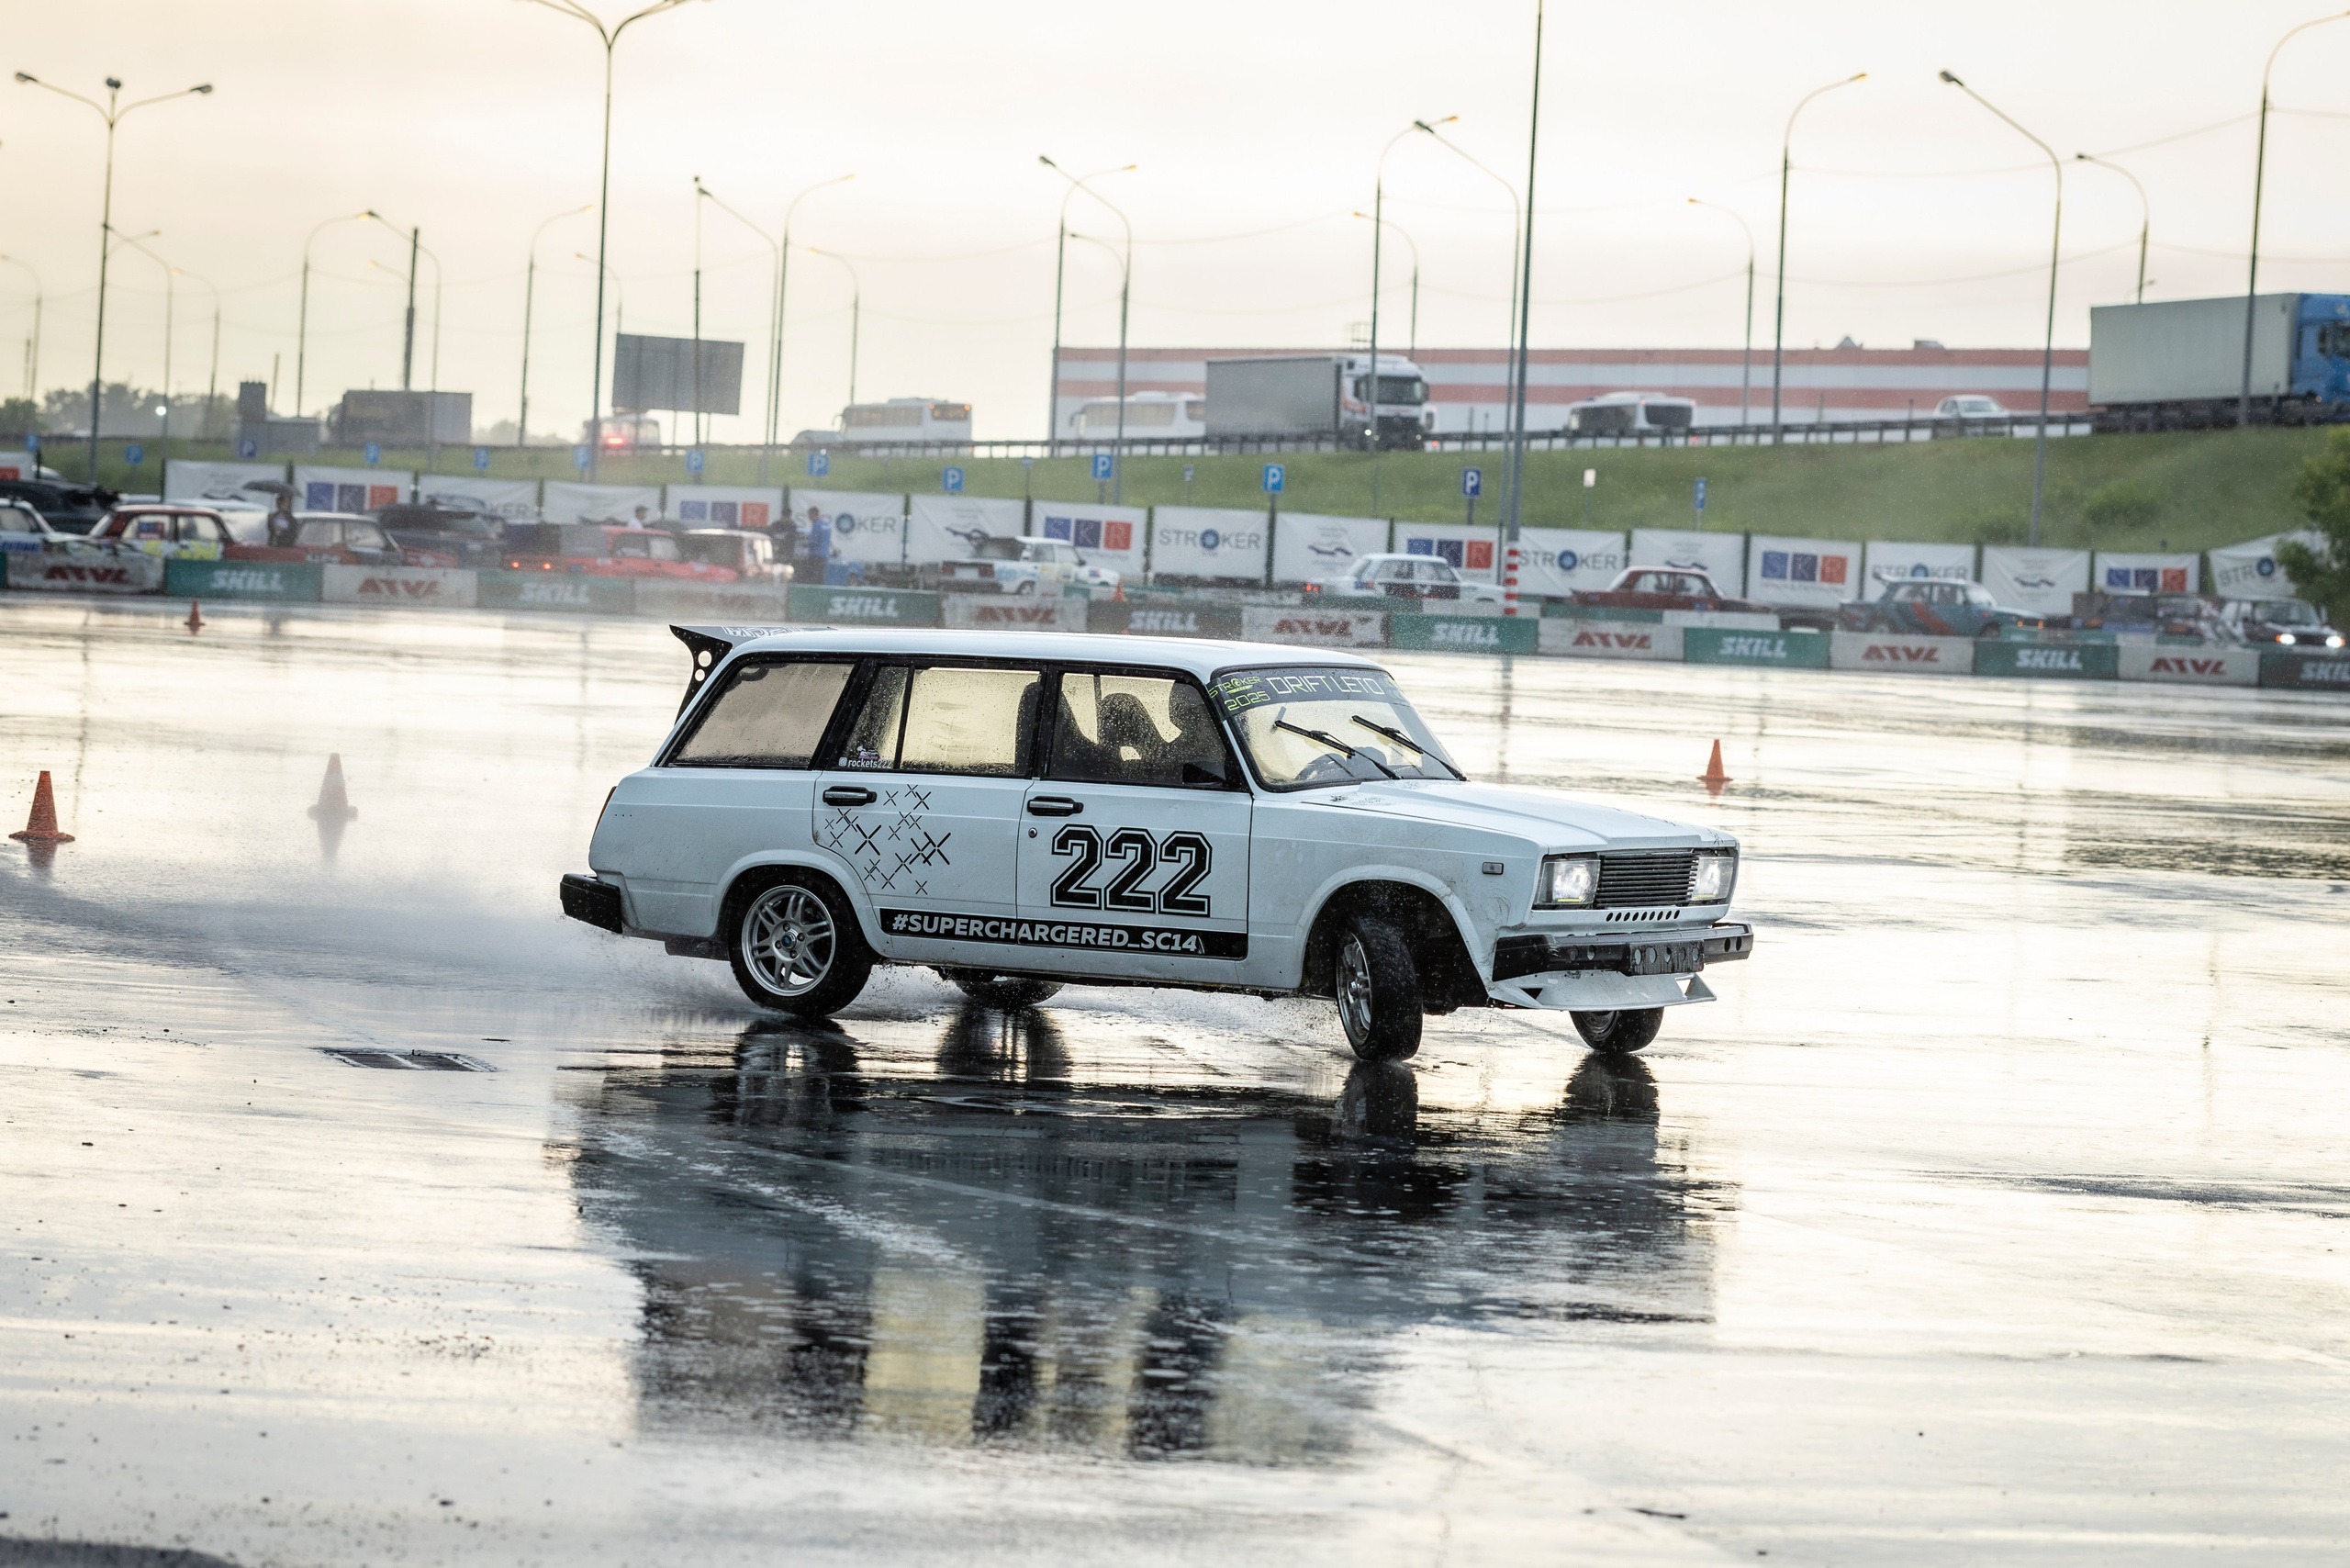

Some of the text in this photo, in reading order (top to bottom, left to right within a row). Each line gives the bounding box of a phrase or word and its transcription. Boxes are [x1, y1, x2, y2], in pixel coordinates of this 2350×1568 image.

[1158, 528, 1260, 551] STROKER
[827, 596, 899, 618] SKILL
[1129, 610, 1199, 632] SKILL
[1718, 636, 1787, 658] SKILL
[2015, 649, 2084, 671] SKILL
[1208, 676, 1262, 698] STROKER
[1266, 676, 1333, 695] DRIFT
[1330, 676, 1385, 696] LETO
[1224, 690, 1271, 711] 2025
[847, 758, 892, 769] rockets222
[1050, 823, 1213, 917] 222
[892, 913, 1197, 952] #SUPERCHARGERED_SC14
